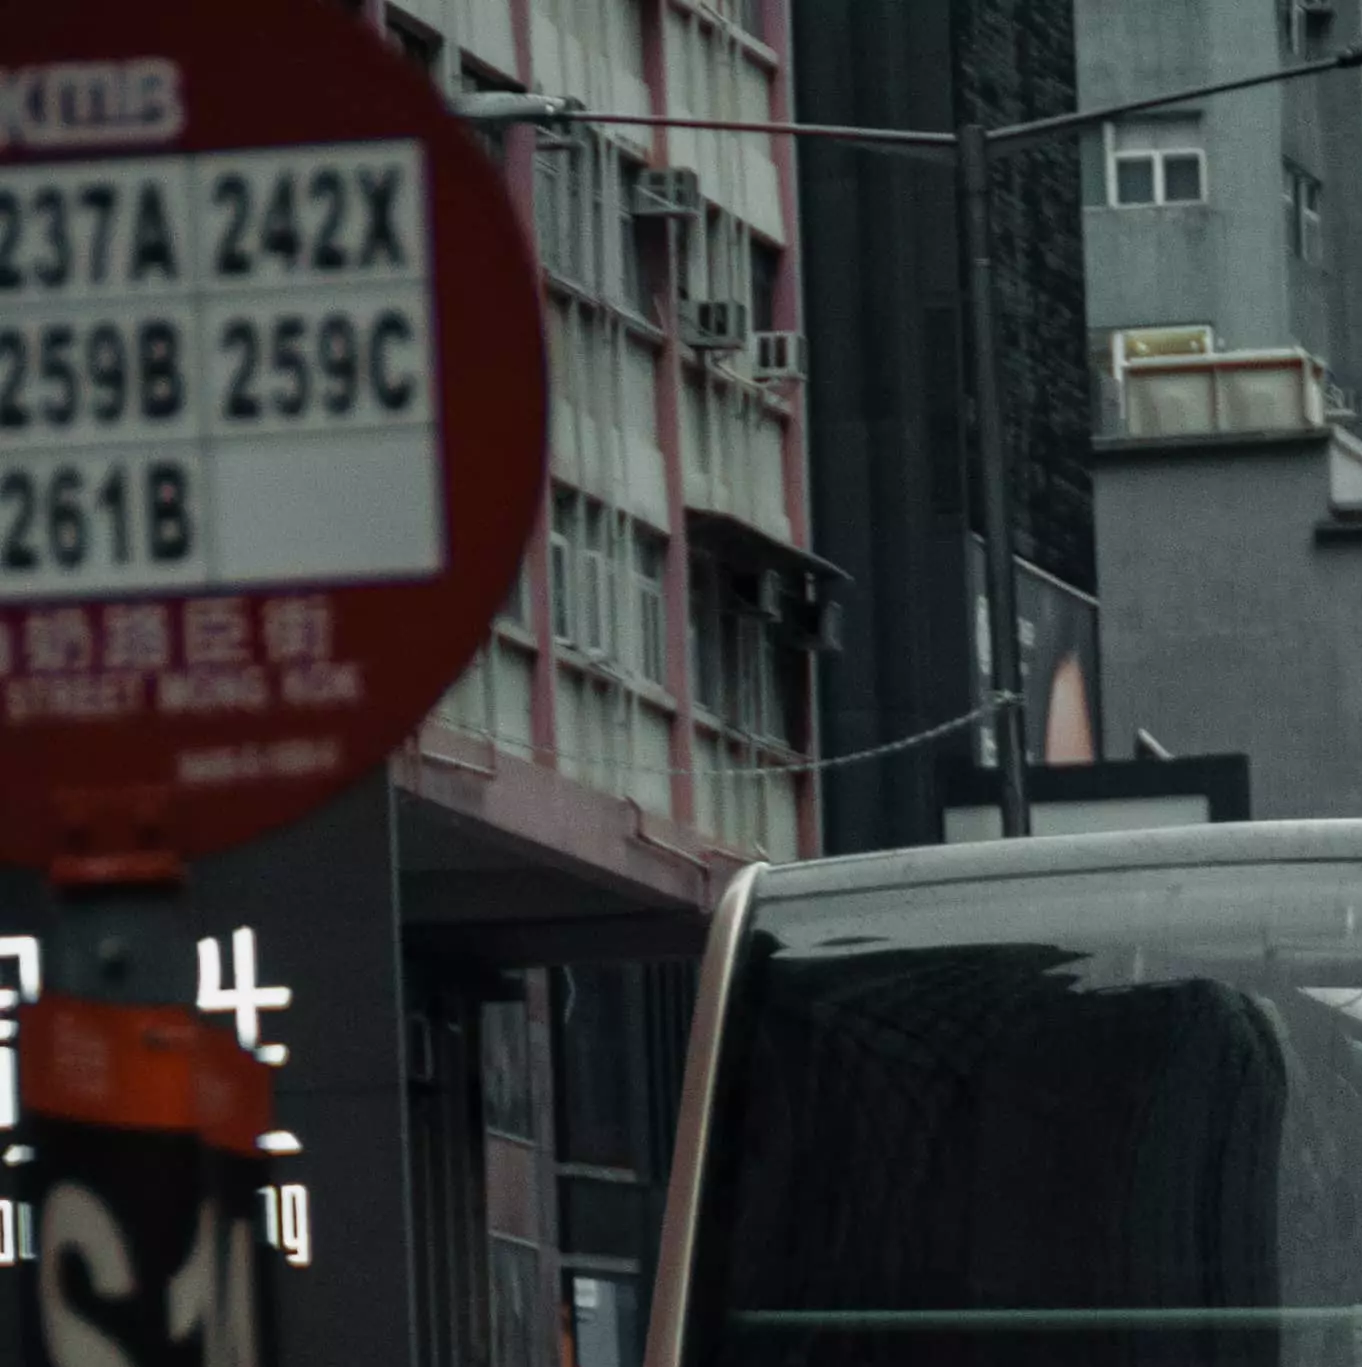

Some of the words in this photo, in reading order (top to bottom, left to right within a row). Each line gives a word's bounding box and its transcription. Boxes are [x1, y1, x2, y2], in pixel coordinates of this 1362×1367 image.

[0, 179, 177, 290] 237A
[213, 165, 407, 279] 242X
[0, 320, 184, 428] 259B
[220, 308, 415, 422] 259C
[1, 458, 191, 570] 261B
